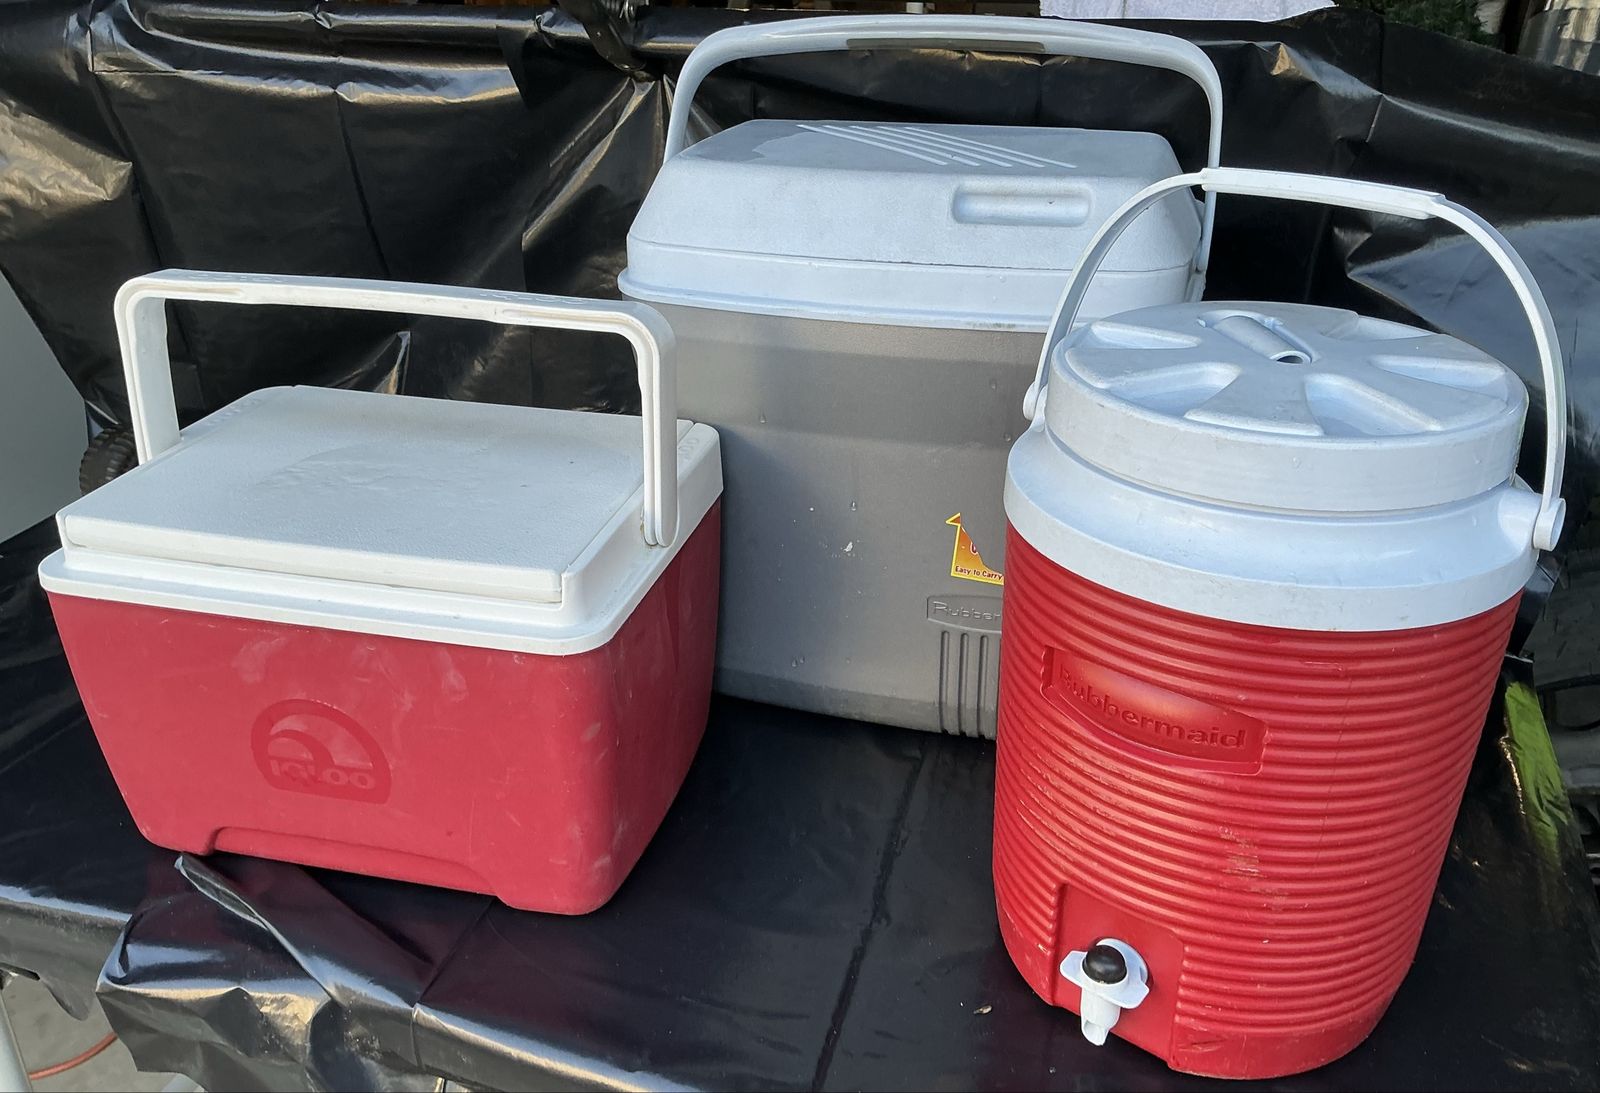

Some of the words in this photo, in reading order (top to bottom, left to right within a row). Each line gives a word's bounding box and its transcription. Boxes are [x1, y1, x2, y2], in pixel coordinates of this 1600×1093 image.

[955, 566, 971, 576] Easy
[982, 570, 1003, 580] Carry
[1060, 664, 1246, 747] Rubbermaid
[269, 759, 376, 790] IGLOO
